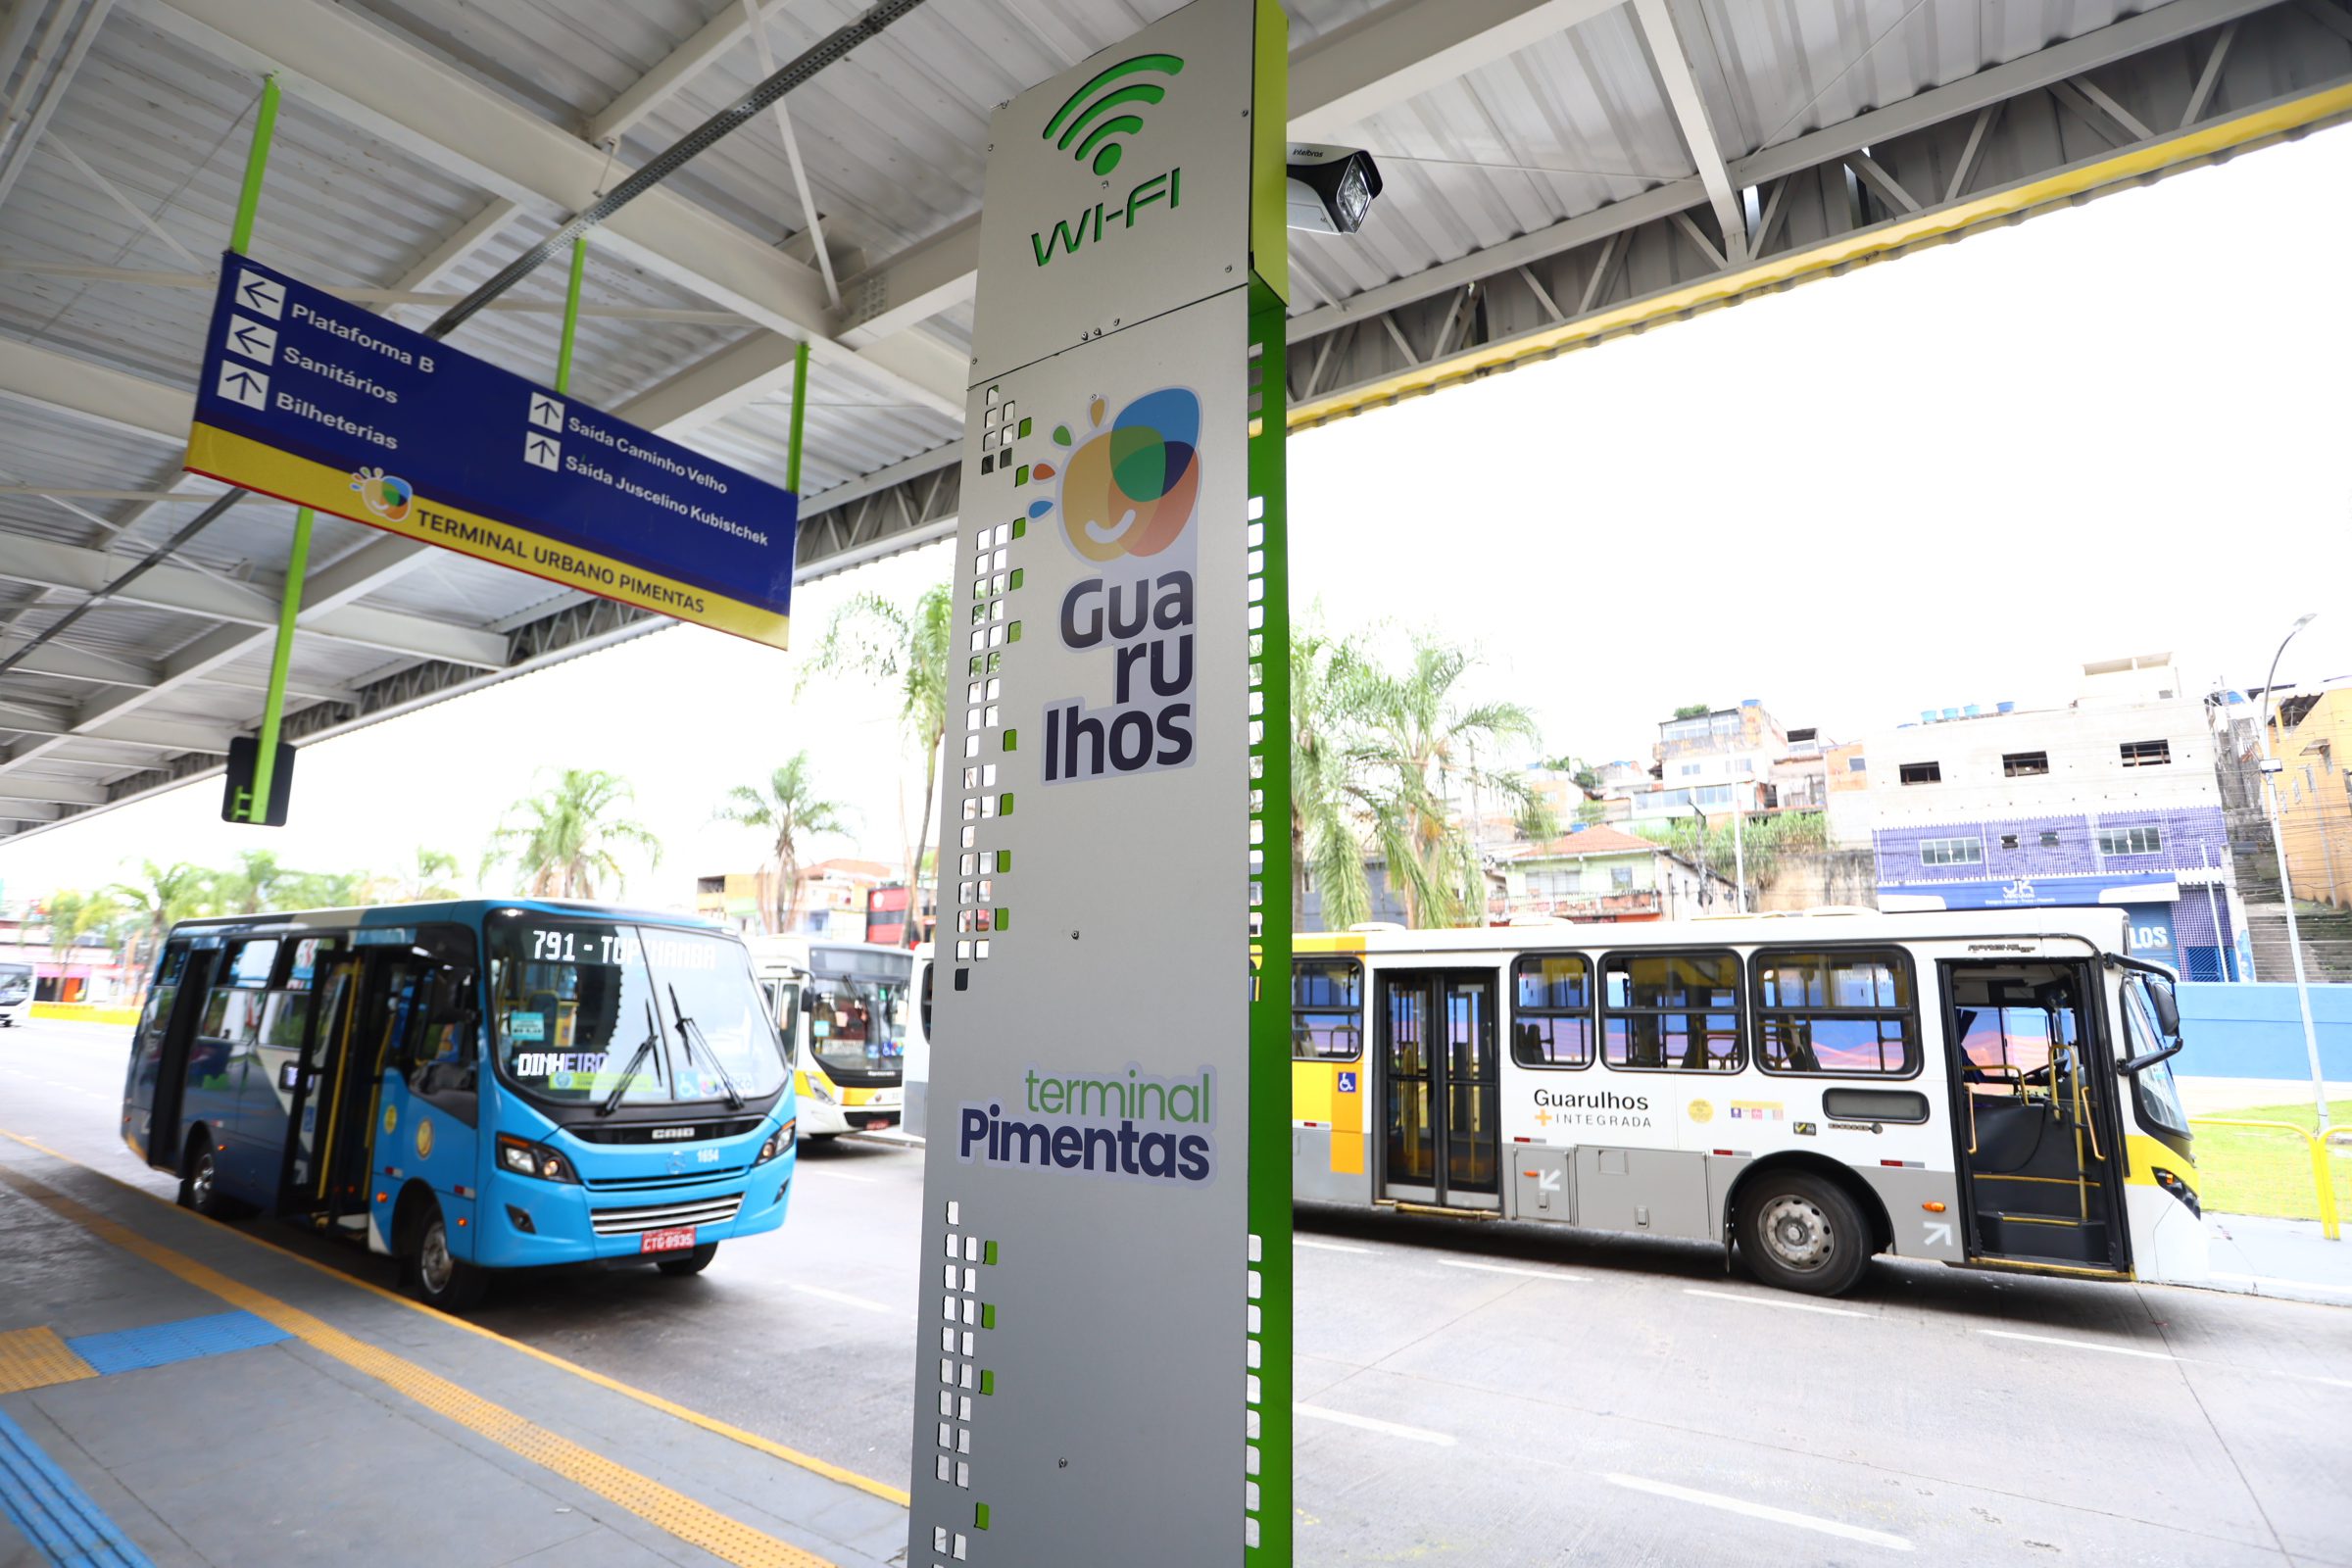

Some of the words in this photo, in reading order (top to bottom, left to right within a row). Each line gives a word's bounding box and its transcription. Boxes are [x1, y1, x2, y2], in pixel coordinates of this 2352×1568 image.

[1031, 167, 1180, 268] WI-FI
[291, 303, 413, 366] Plataforma
[418, 356, 435, 374] B
[283, 347, 399, 404] Sanitários
[276, 392, 398, 450] Bilheterias
[568, 416, 614, 447] Saída
[616, 437, 686, 477] Caminho
[687, 466, 728, 494] Velho
[564, 455, 612, 486] Saída
[615, 476, 688, 515] Juscelino
[690, 506, 769, 547] Kubistchek
[416, 509, 528, 559] TERMINAL
[534, 546, 613, 585] URBANO
[619, 574, 705, 612] PIMENTAS
[1060, 570, 1194, 649] Gua
[1116, 633, 1193, 705] ru
[1045, 703, 1193, 781] lhos
[2002, 880, 2034, 895] JK
[533, 930, 575, 961] 791
[517, 1053, 609, 1076] DINHEIRO
[1025, 1069, 1209, 1123] terminal
[1534, 1089, 1648, 1110] Guarulhos
[960, 1103, 1210, 1181] Pimentas
[1556, 1113, 1651, 1128] INTEGRADA
